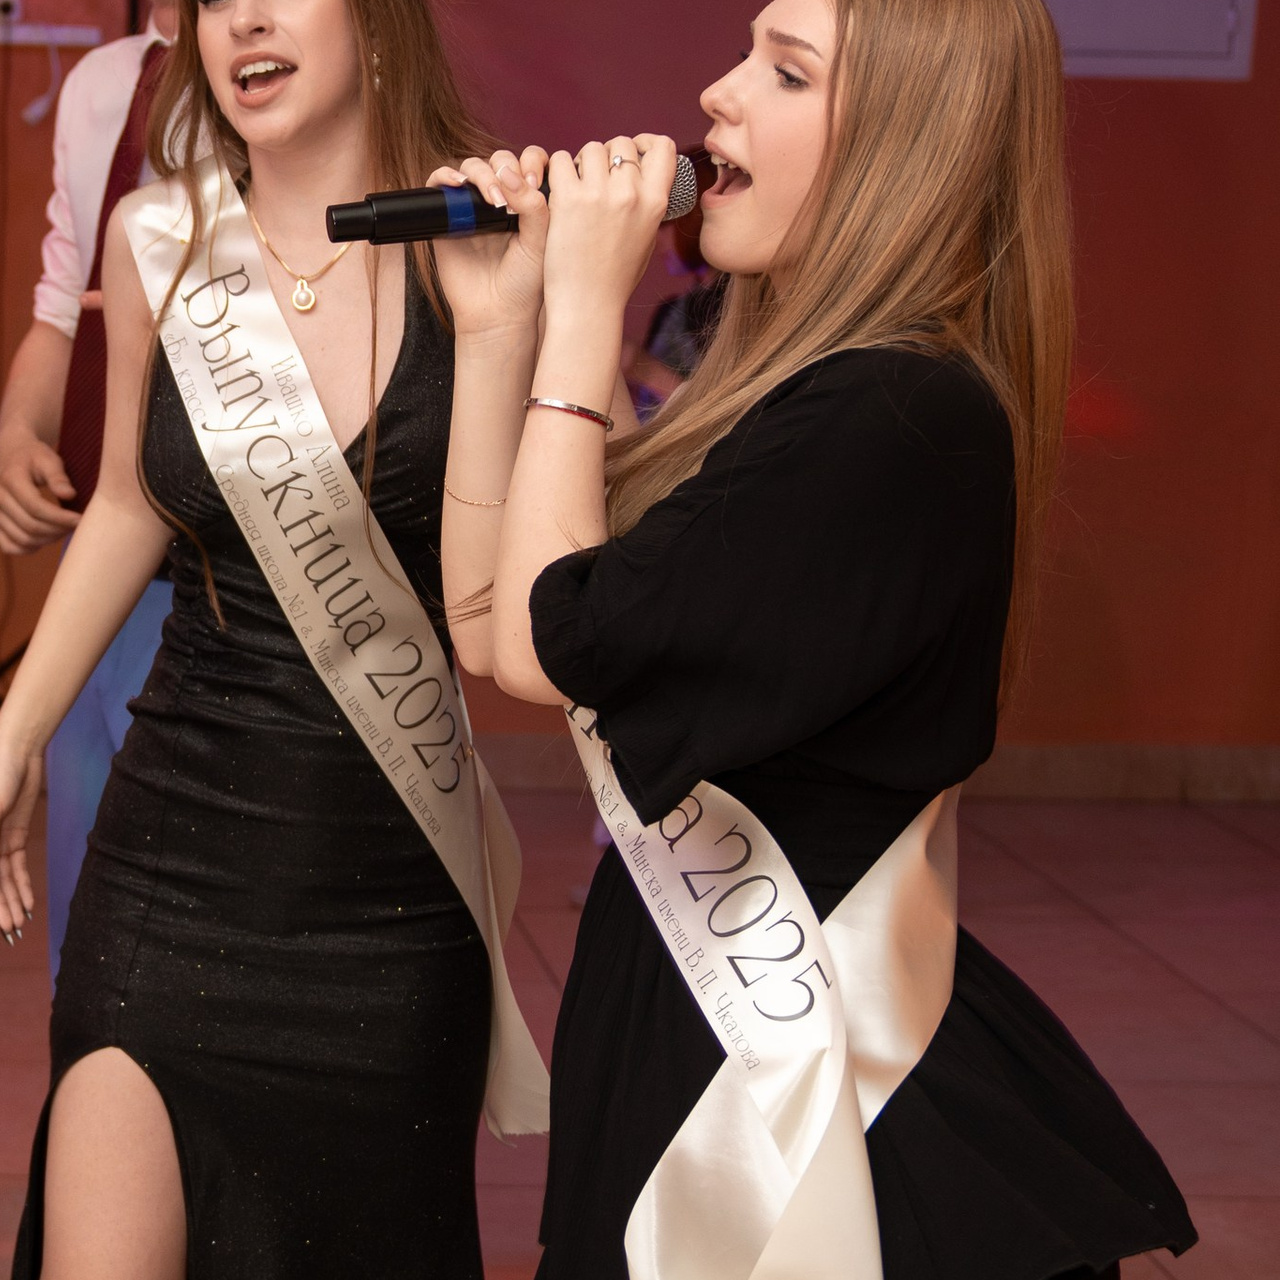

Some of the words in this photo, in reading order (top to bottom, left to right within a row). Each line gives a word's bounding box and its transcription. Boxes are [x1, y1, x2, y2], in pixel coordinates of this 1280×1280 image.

[175, 368, 207, 422] класс
[271, 354, 314, 438] Ивашко
[306, 444, 351, 512] Алина
[181, 263, 386, 657] Выпускница
[364, 634, 468, 794] 2025
[215, 464, 262, 542] Средняя
[256, 544, 288, 592] школа
[282, 593, 308, 622] №1
[310, 638, 349, 695] Минска
[346, 695, 381, 745] имени
[376, 737, 394, 758] В.
[388, 754, 407, 777] П.
[404, 773, 441, 837] Чкалова
[593, 783, 619, 818] №1
[626, 833, 663, 899] Минска
[656, 898, 690, 952] имени
[685, 947, 705, 972] В.
[696, 968, 718, 995] П.
[714, 991, 761, 1071] Чкалова
[680, 823, 833, 1022] 2025
